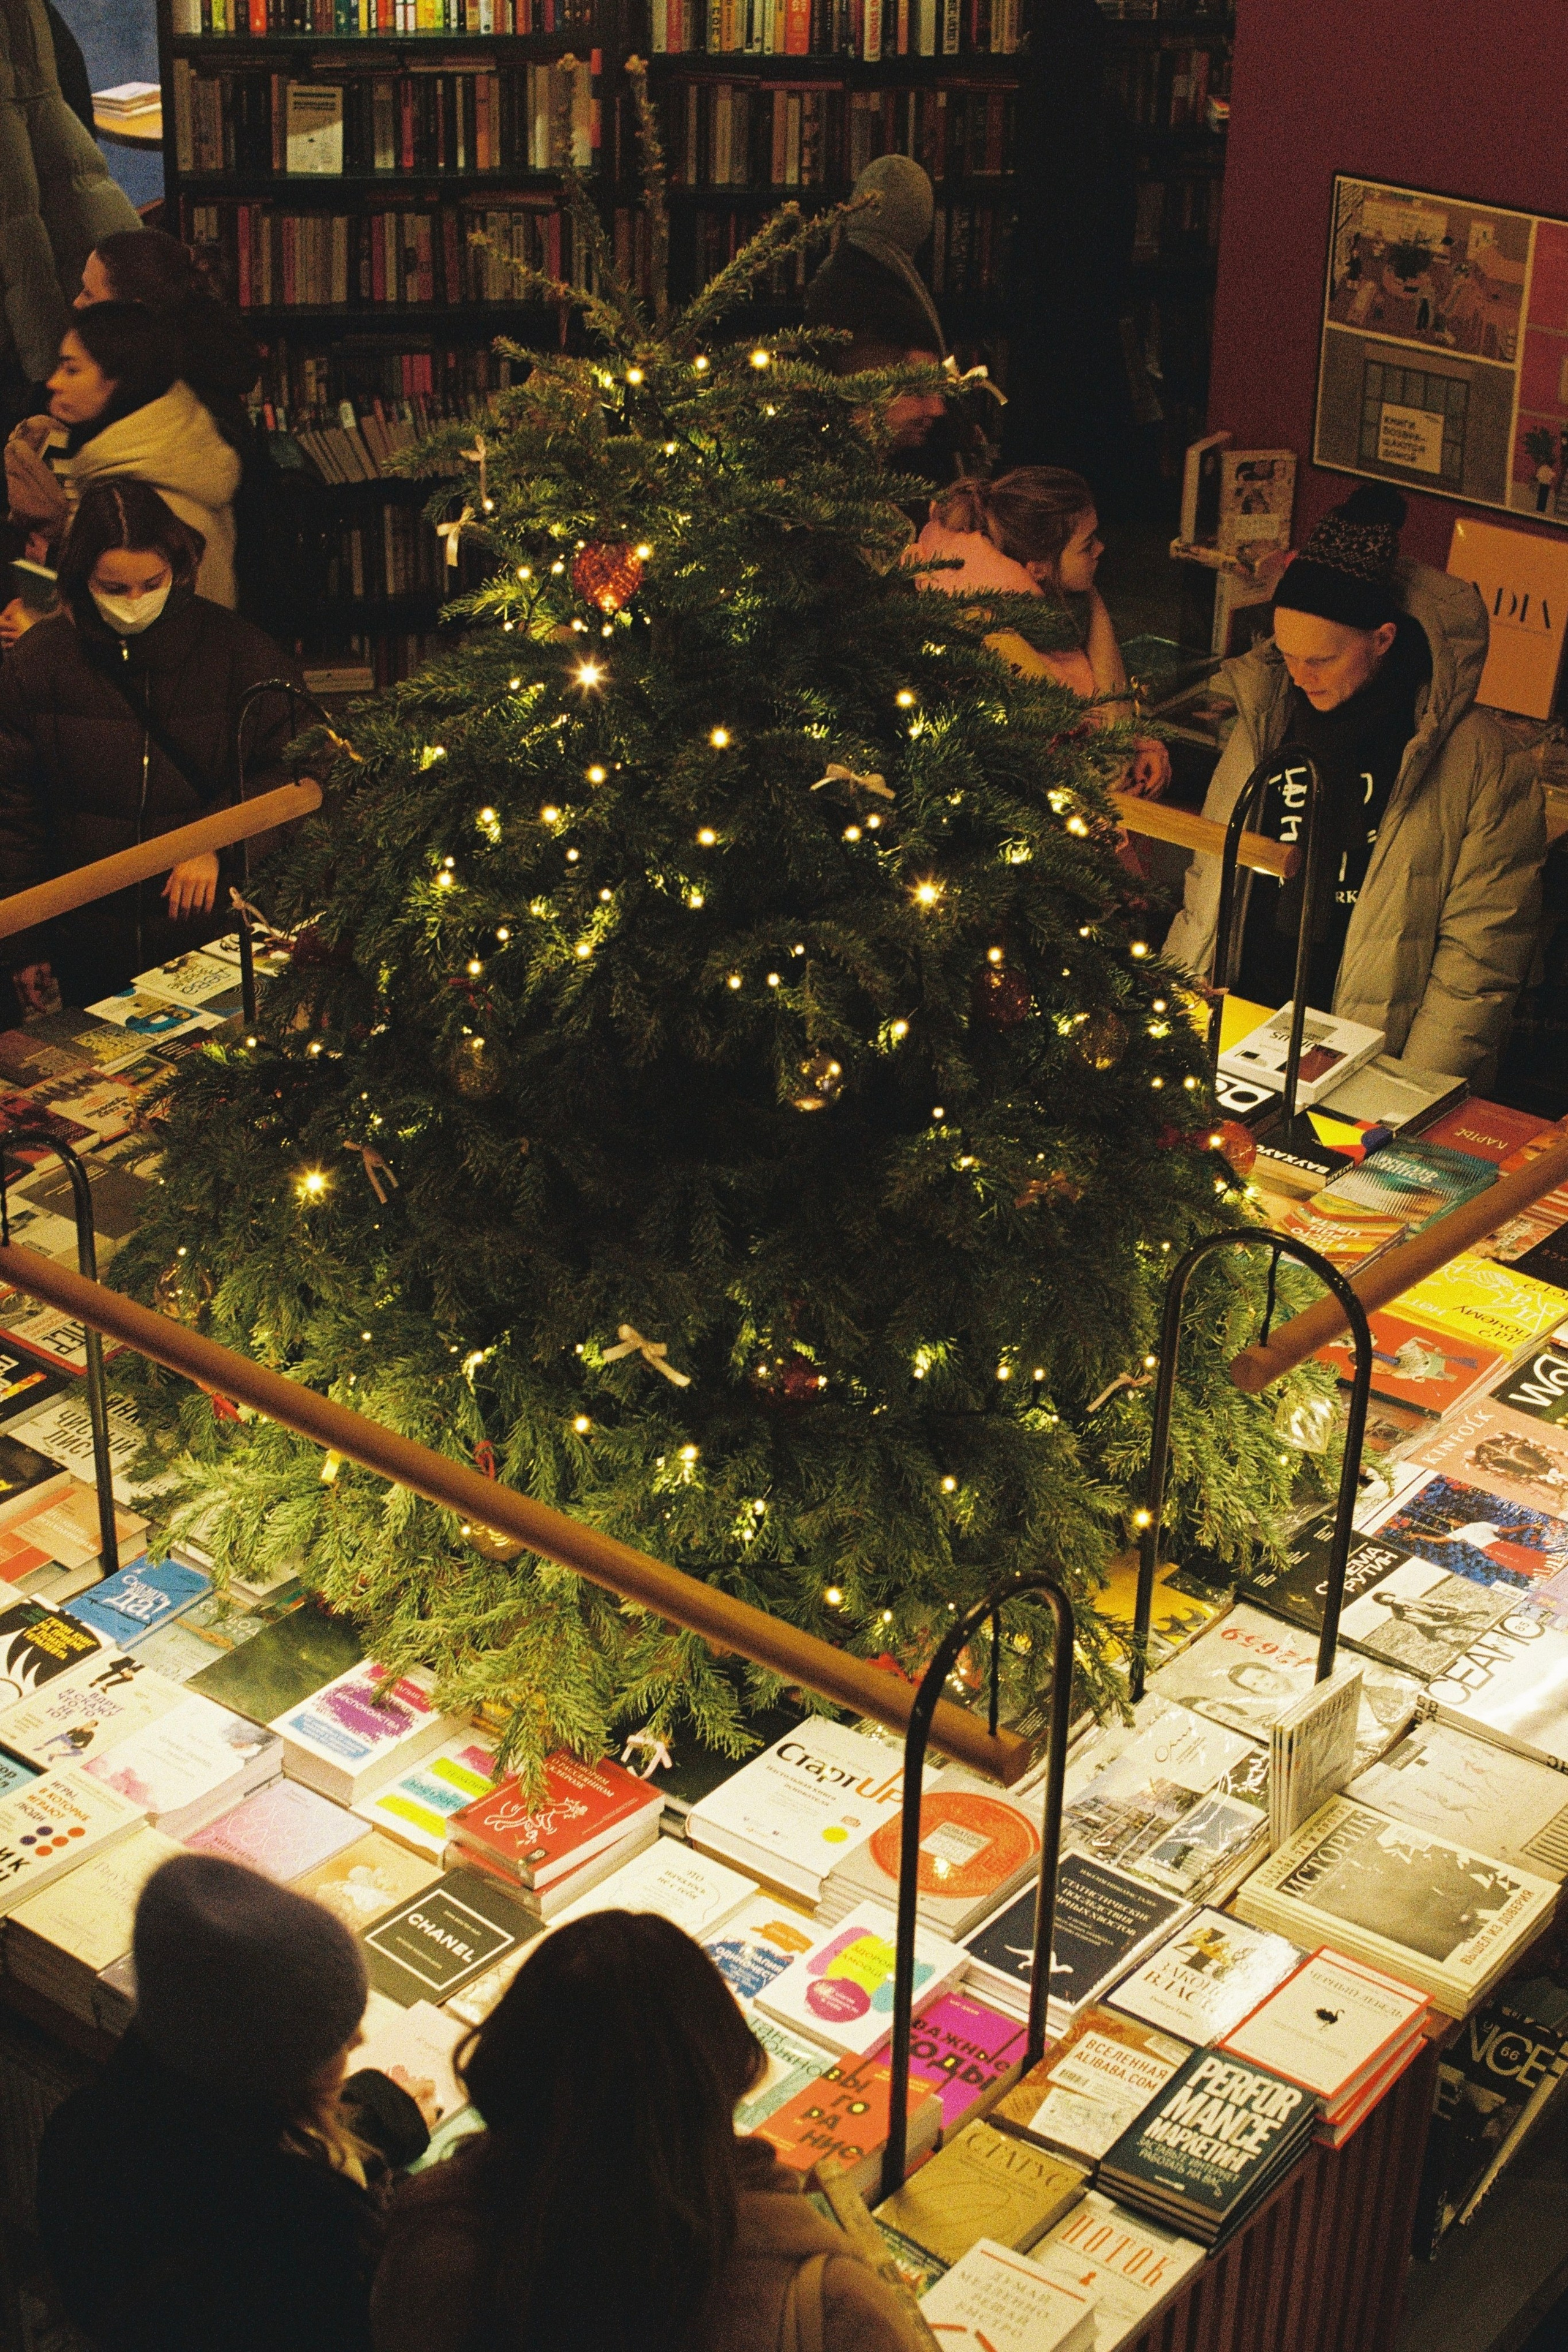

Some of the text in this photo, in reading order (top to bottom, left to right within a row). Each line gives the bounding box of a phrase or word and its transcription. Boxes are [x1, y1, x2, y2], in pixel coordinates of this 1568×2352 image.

[1256, 1144, 1330, 1174] БАУХАУС
[57, 1409, 137, 1457] ЧИСЫЙ
[1421, 1409, 1495, 1465] KINFOLK
[337, 1692, 402, 1730] БЕСПОКОЙСТВА
[27, 1794, 66, 1819] ИГРАЮТ
[47, 1792, 92, 1822] КОТОРЫЕ
[1280, 1809, 1379, 1898] ИСТОРИК
[408, 1912, 476, 1964] CHANEL
[1460, 1889, 1535, 1966] ВЫШЕЛ ИЗ ДОВЕРИЯ
[1074, 2050, 1158, 2092] ALIBABA.COM
[1085, 2038, 1169, 2079] ВСЕЛЕННАЯ
[1500, 2046, 1520, 2062] 66
[1185, 2056, 1303, 2123] PERFOR
[1143, 2116, 1257, 2173] МАРКЕТИНГ
[1159, 2084, 1283, 2156] MANCE
[967, 2132, 1069, 2190] СТАТУС
[1061, 2214, 1175, 2287] ПОТОК
